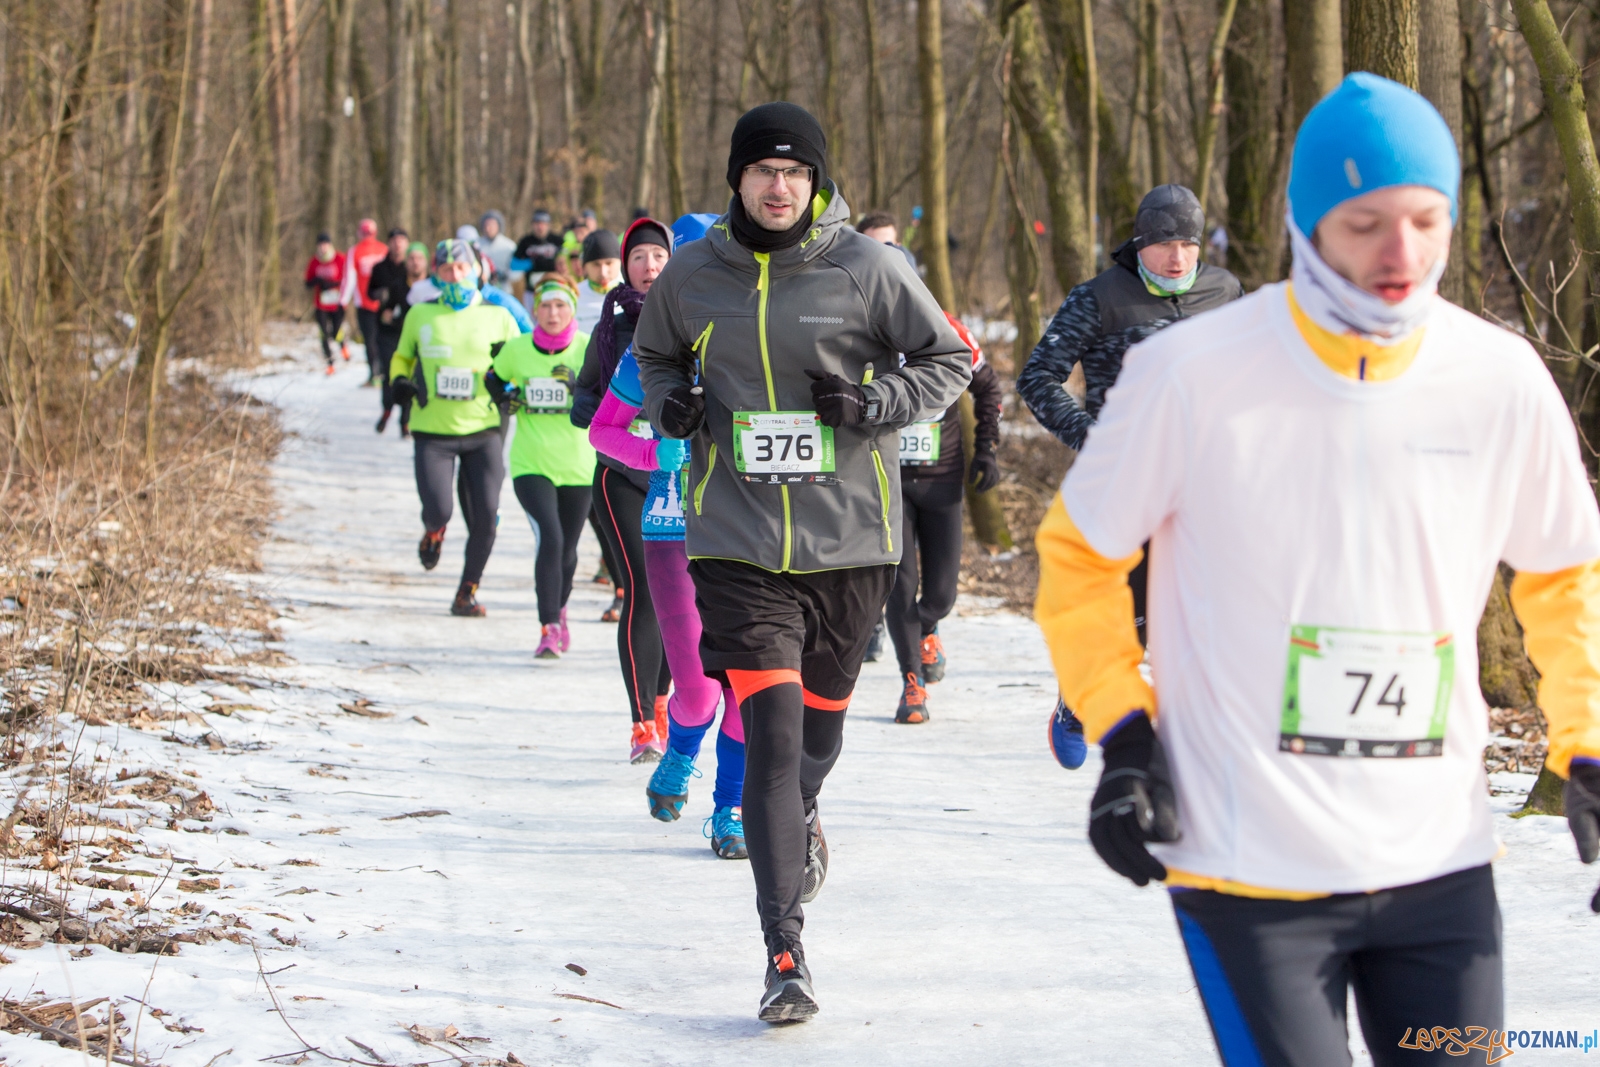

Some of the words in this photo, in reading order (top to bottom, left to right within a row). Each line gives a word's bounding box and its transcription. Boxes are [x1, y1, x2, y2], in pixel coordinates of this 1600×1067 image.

[441, 376, 470, 390] 388
[530, 388, 565, 402] 1938
[755, 434, 814, 462] 376
[770, 464, 800, 472] BIEGACZ
[1345, 671, 1407, 717] 74
